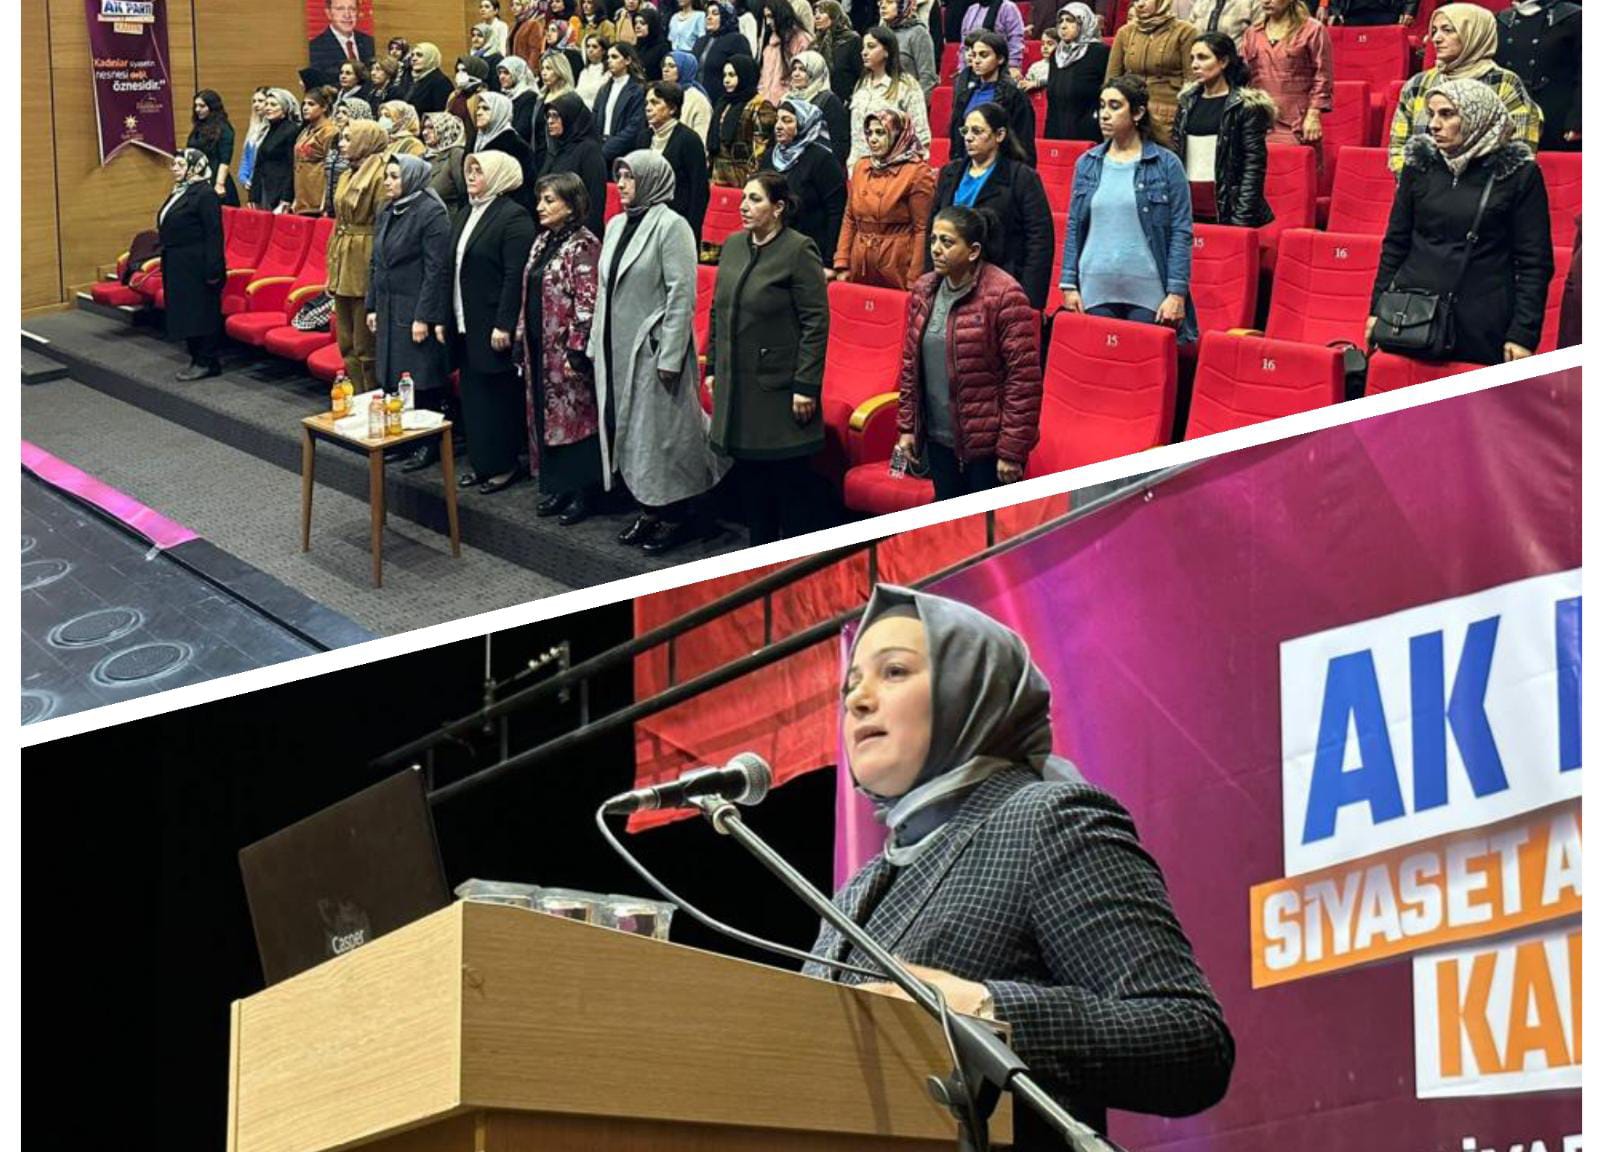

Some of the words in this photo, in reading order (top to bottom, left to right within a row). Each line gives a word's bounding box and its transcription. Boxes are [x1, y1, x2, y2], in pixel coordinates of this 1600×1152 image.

[104, 0, 122, 12] AK
[1335, 247, 1347, 259] 16
[1106, 334, 1118, 347] 15
[1262, 358, 1276, 371] 16
[1301, 614, 1510, 846] AK
[1436, 931, 1582, 1078] KA
